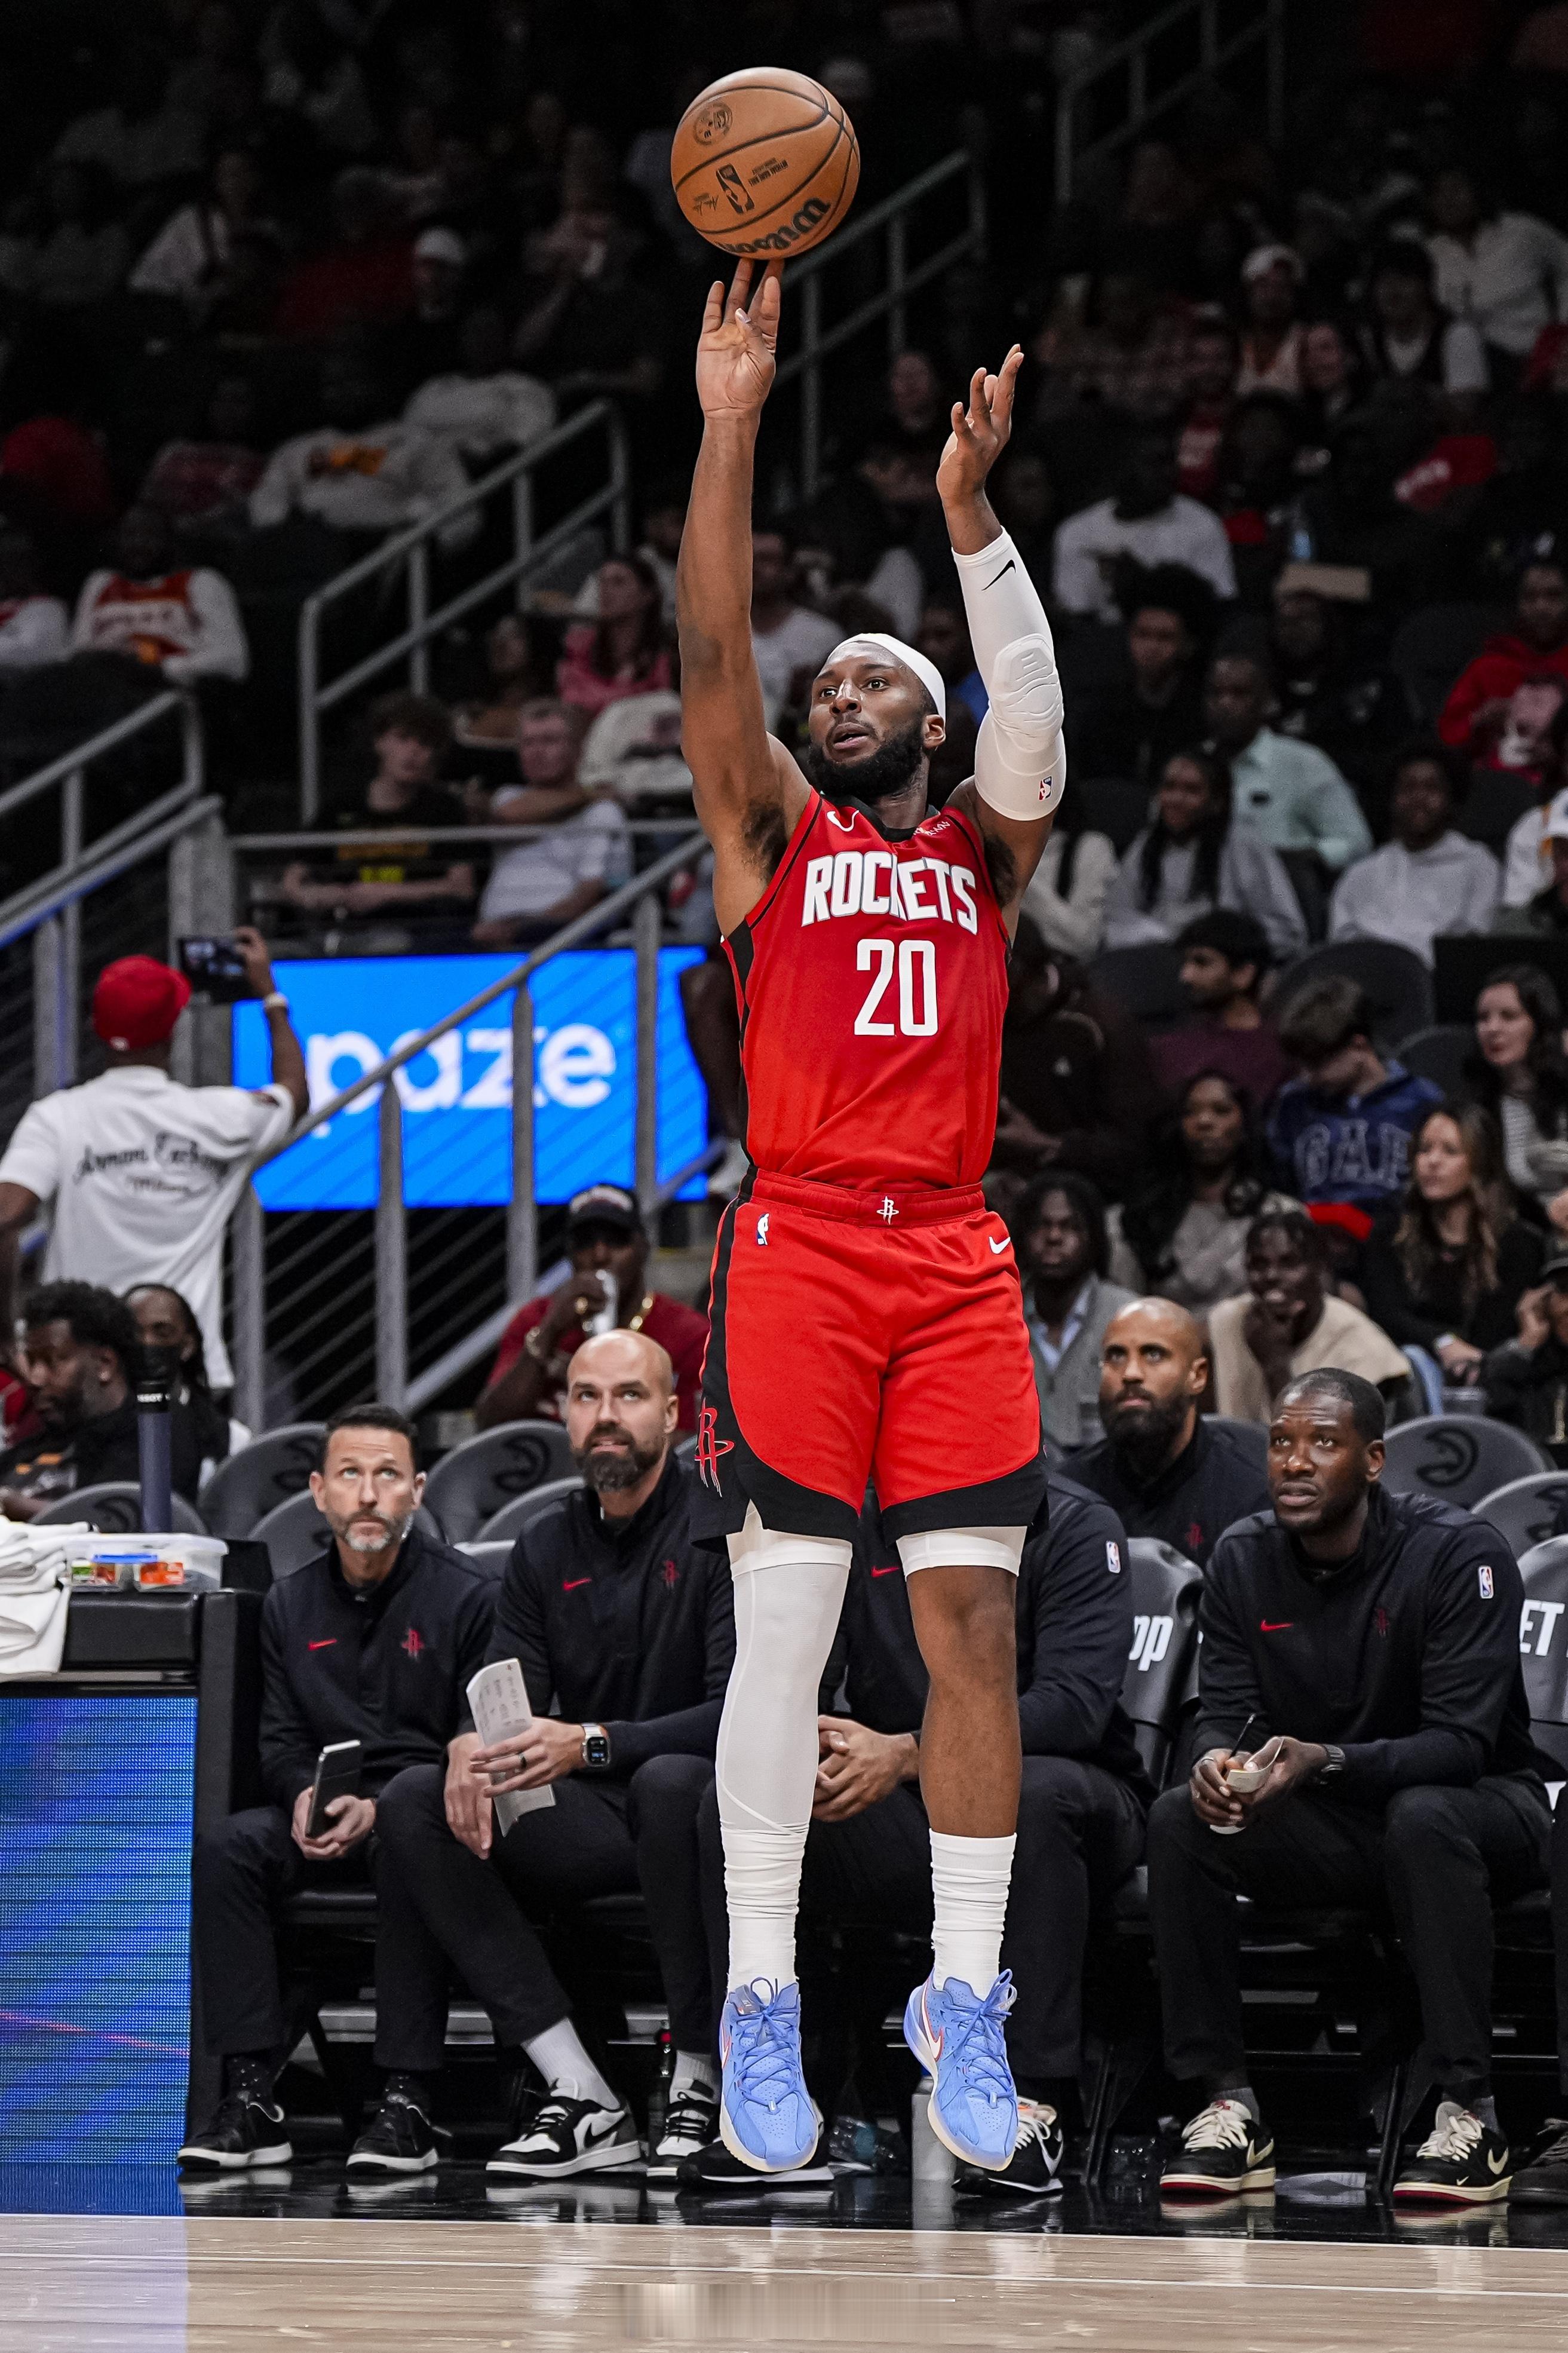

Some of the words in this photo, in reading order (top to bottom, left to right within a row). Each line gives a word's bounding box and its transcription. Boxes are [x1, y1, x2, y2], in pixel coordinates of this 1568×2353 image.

[801, 851, 978, 935] ROCKETS
[854, 938, 938, 1037] 20
[306, 1023, 616, 1138] paze
